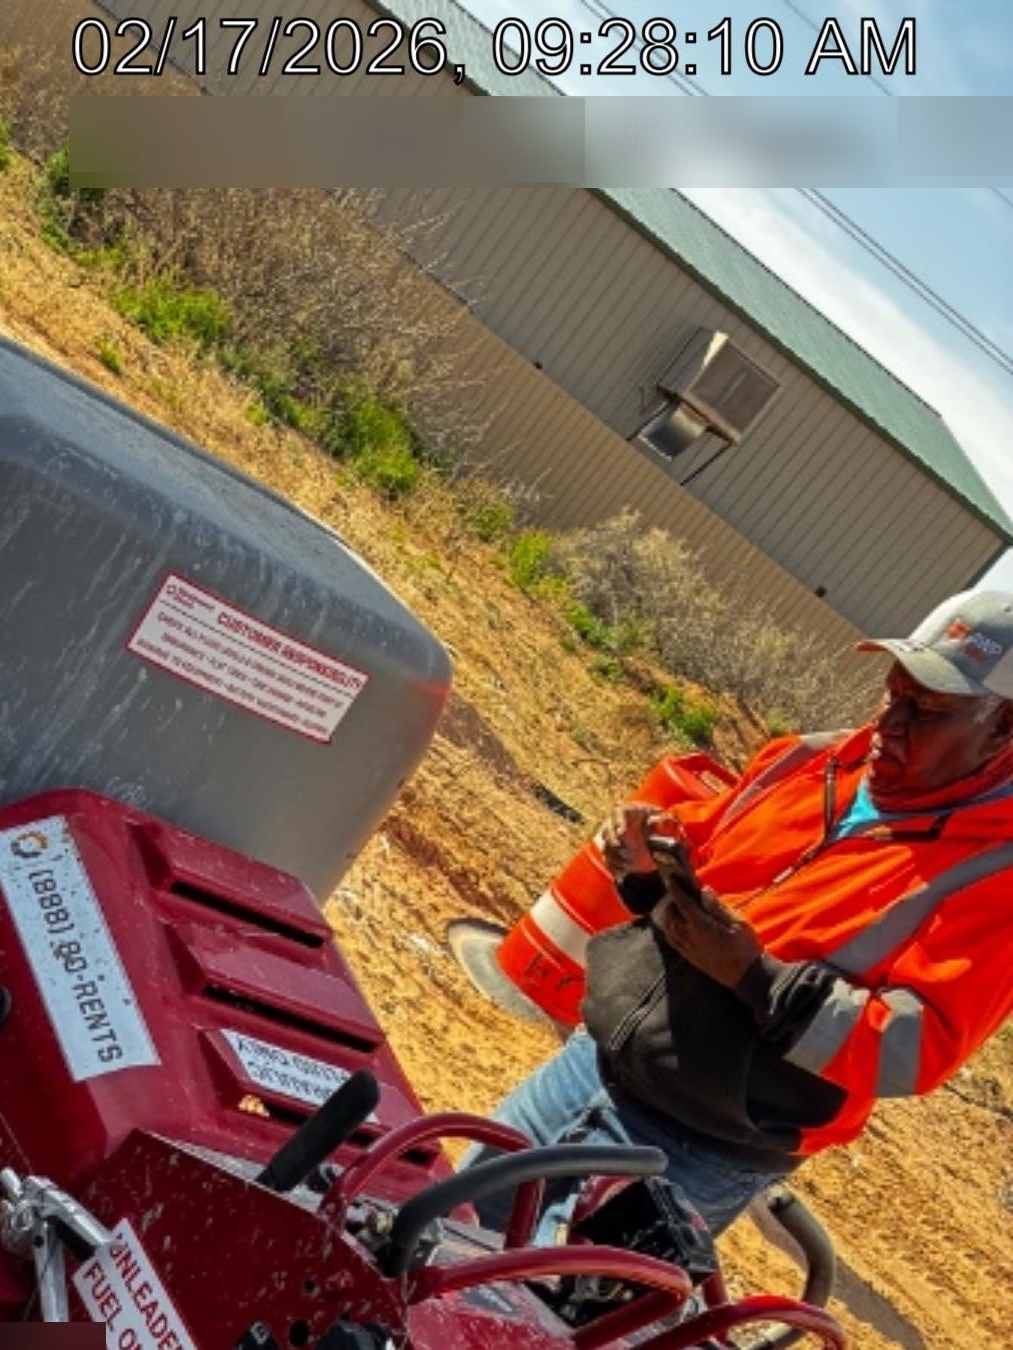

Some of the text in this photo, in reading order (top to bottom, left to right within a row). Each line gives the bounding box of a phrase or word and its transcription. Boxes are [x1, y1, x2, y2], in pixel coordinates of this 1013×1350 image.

[29, 868, 123, 1063] (888) 80-RENTS
[84, 1262, 123, 1333] FUEL
